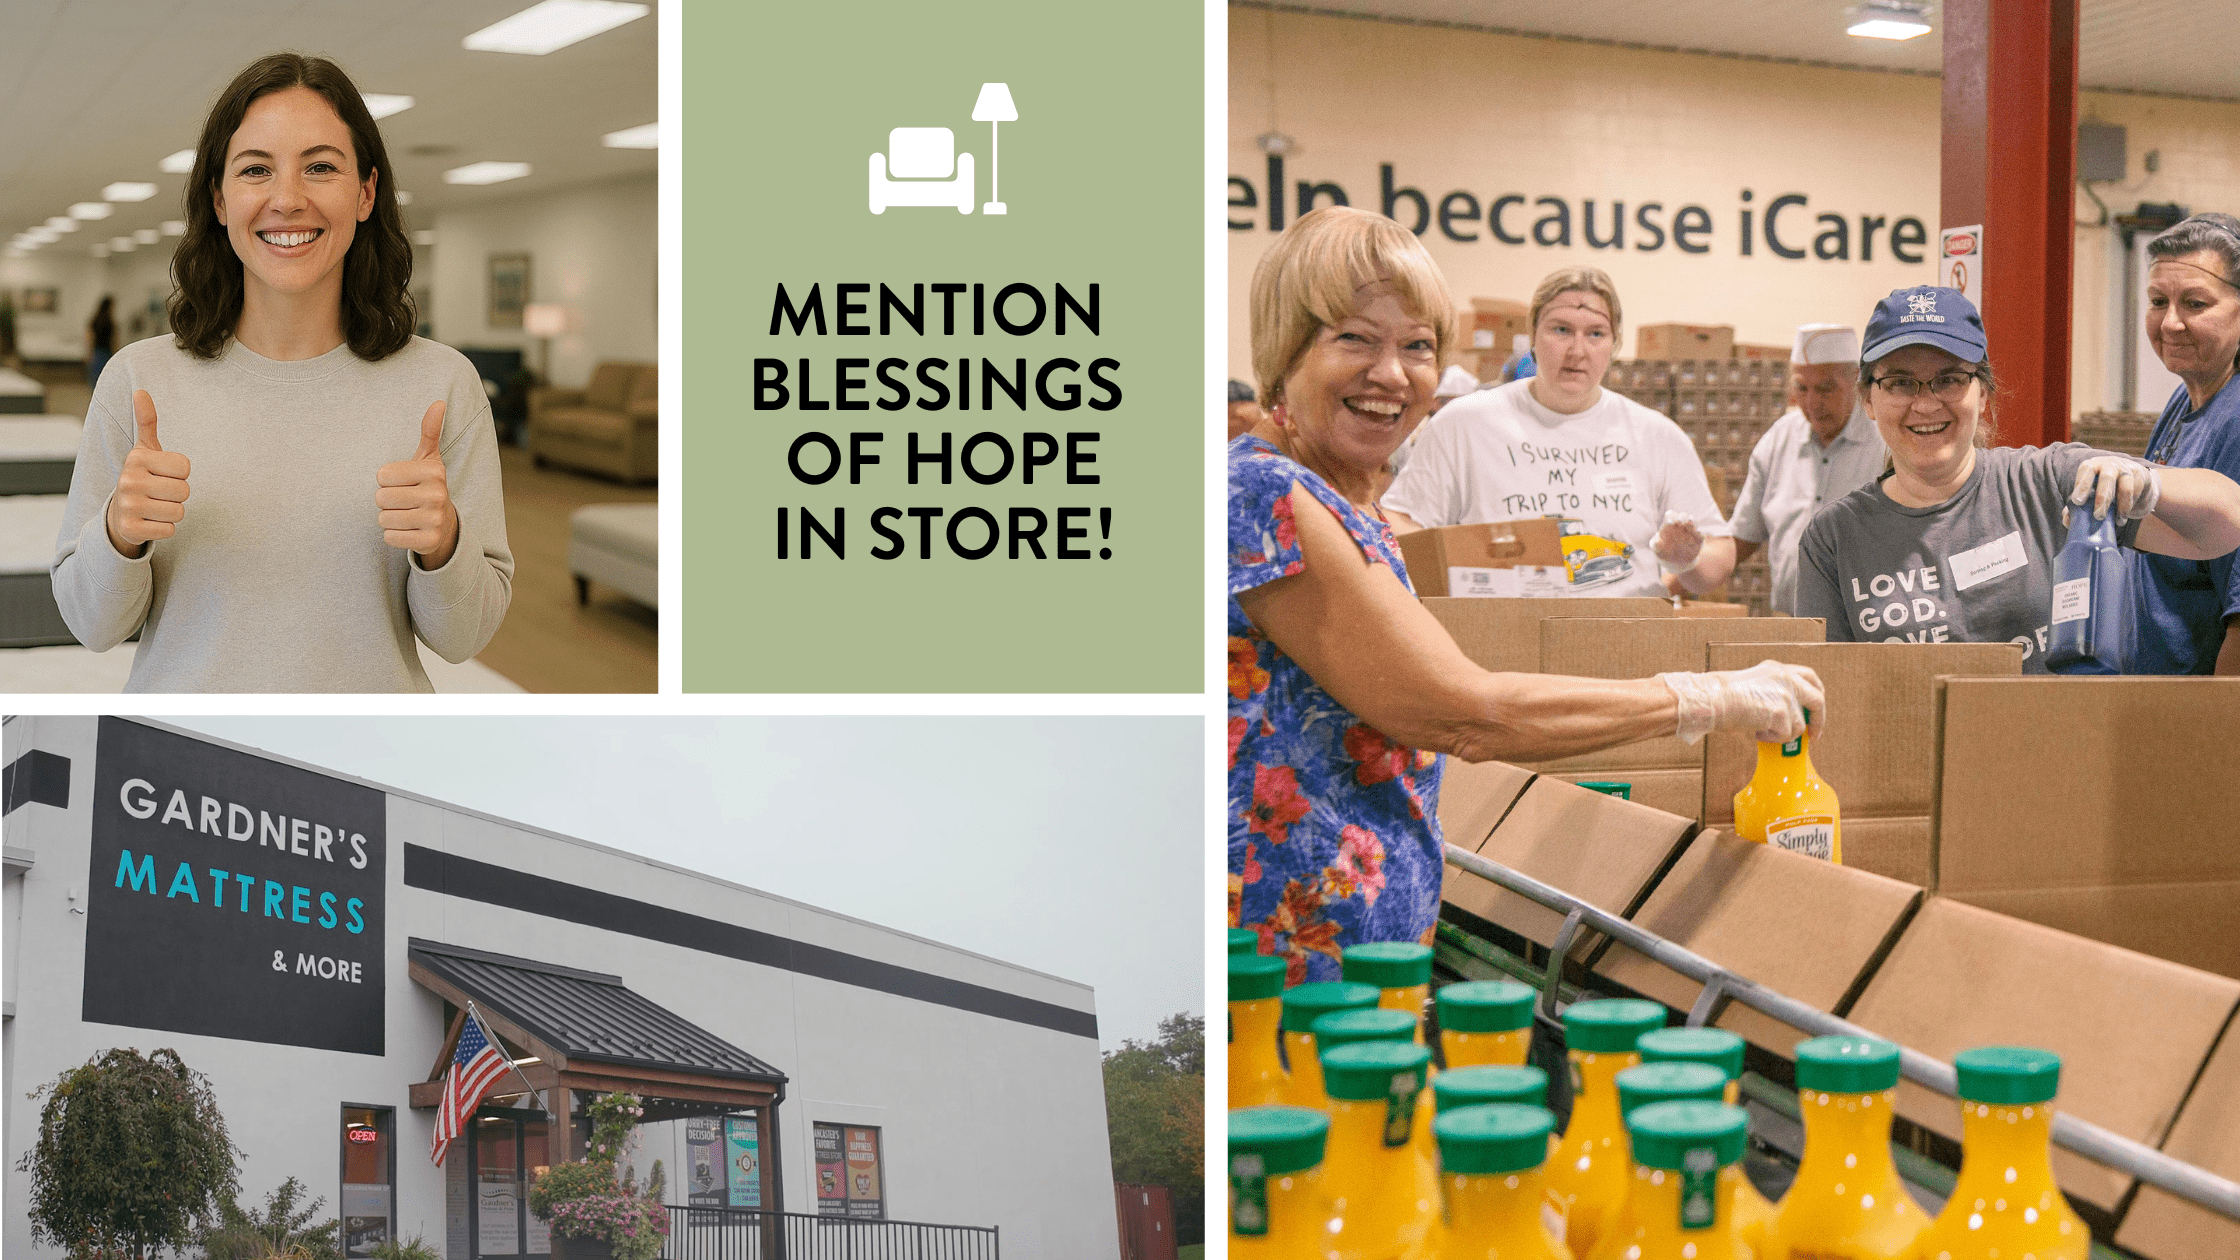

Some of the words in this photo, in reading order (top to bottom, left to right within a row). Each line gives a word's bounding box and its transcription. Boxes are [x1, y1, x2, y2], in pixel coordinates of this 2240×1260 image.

[1379, 162, 1713, 253] because
[1739, 188, 1928, 265] iCare
[1900, 314, 1914, 323] TASTE
[1915, 314, 1925, 322] THE
[1926, 314, 1945, 323] WORLD
[1507, 445, 1516, 466] I
[1521, 442, 1629, 465] SURVIVED
[1548, 468, 1577, 485] MY
[1502, 492, 1548, 514] TRIP
[1557, 493, 1580, 510] TO
[1593, 493, 1632, 512] NYC
[1851, 566, 1941, 602] LOVE
[1859, 598, 1947, 633] GOD.
[1866, 624, 1949, 644] VE
[119, 777, 369, 870] GARDNER'S
[1777, 827, 1828, 852] Simply
[115, 849, 366, 934] MATTRESS
[272, 949, 288, 973] &
[296, 953, 362, 984] MORE
[349, 1130, 377, 1141] OPEN
[688, 1129, 716, 1141] DECISION
